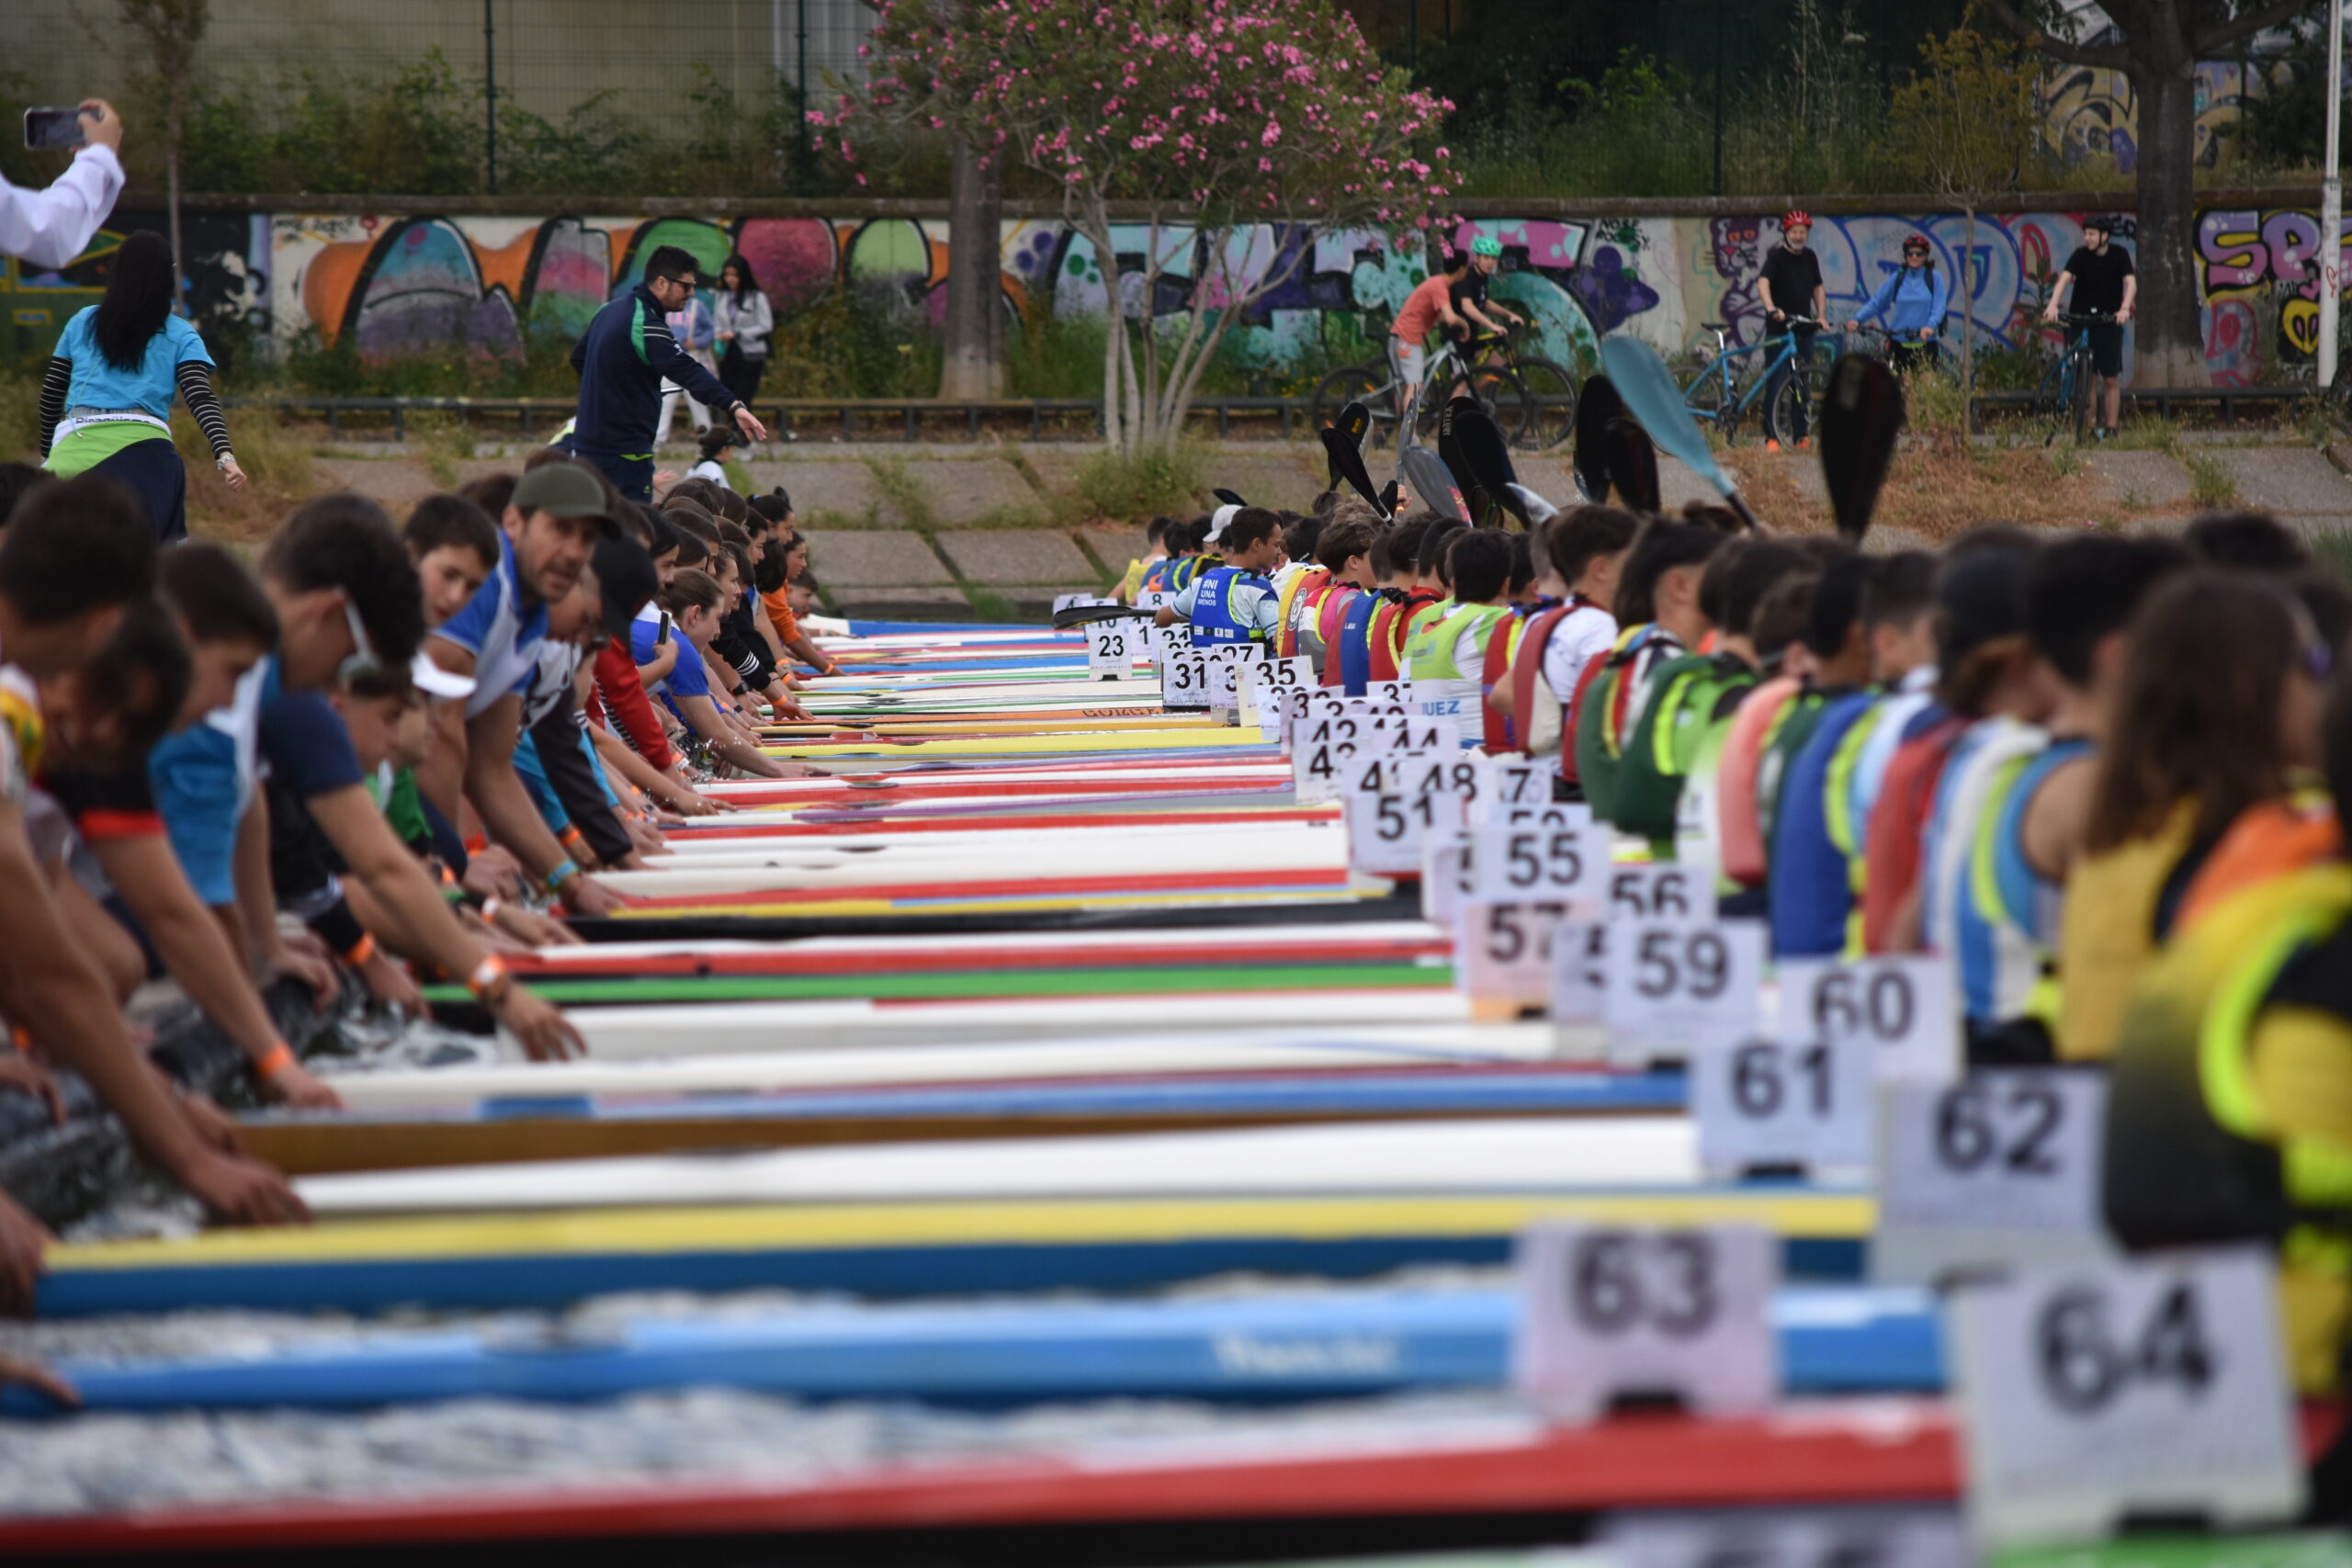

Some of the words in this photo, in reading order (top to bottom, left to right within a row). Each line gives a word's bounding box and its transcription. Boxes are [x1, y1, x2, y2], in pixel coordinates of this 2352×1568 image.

[1197, 598, 1216, 606] MENOS
[1200, 590, 1216, 599] UNA
[1203, 579, 1218, 590] #NI
[1098, 635, 1125, 657] 23
[1138, 625, 1149, 645] 1
[1175, 663, 1205, 689] 31
[1256, 660, 1296, 686] 35
[1422, 700, 1460, 716] UEZ
[1419, 763, 1476, 803] 48
[1377, 795, 1433, 841] 51
[1507, 832, 1582, 887] 55
[1611, 872, 1689, 918] 56
[1634, 931, 1731, 998] 59
[1812, 966, 1915, 1039] 60
[1730, 1040, 1834, 1118] 61
[1933, 1084, 2065, 1176] 62
[1567, 1229, 1722, 1338] 63
[2034, 1282, 2218, 1415] 64
